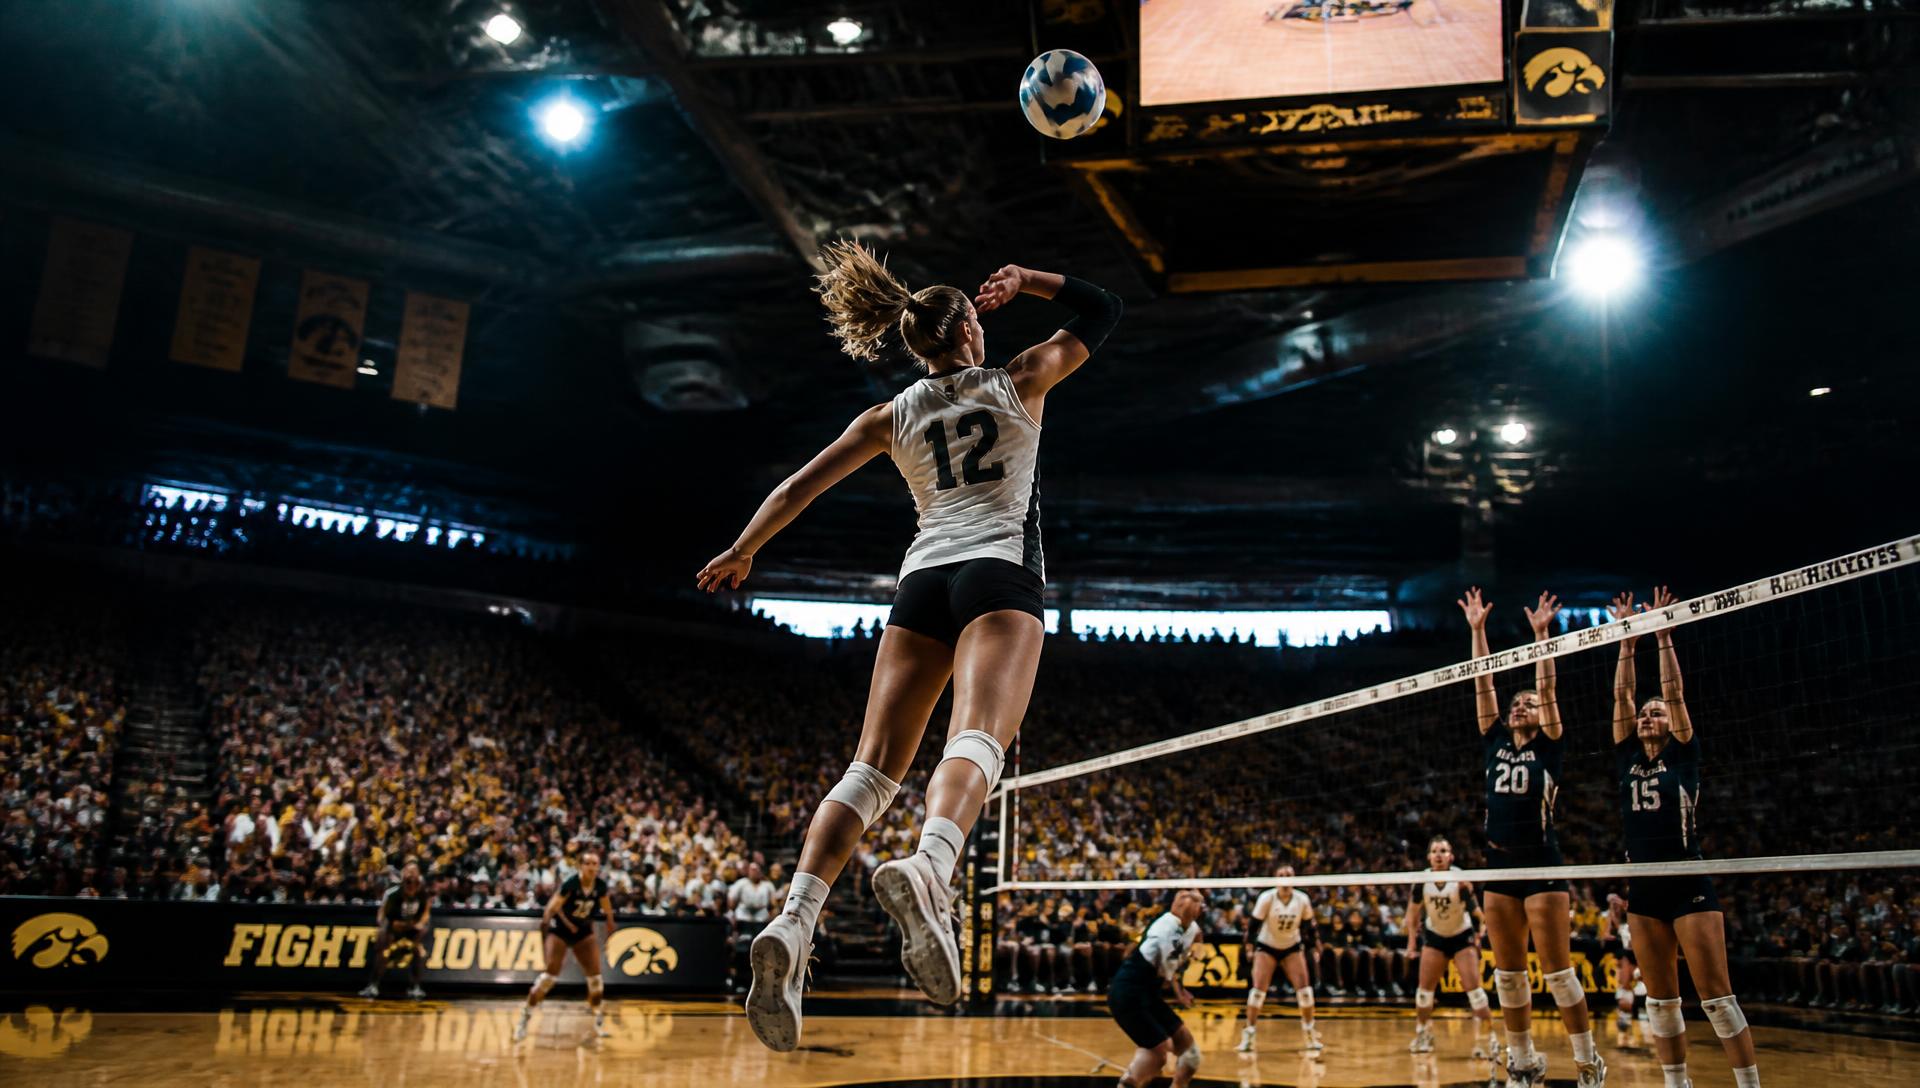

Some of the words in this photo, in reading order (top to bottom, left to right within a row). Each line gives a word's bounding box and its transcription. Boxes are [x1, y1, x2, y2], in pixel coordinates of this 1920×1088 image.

[924, 409, 1004, 490] 12
[1494, 762, 1529, 794] 20
[1630, 777, 1661, 811] 15
[223, 923, 379, 968] FIGHT
[426, 927, 547, 970] IOWA
